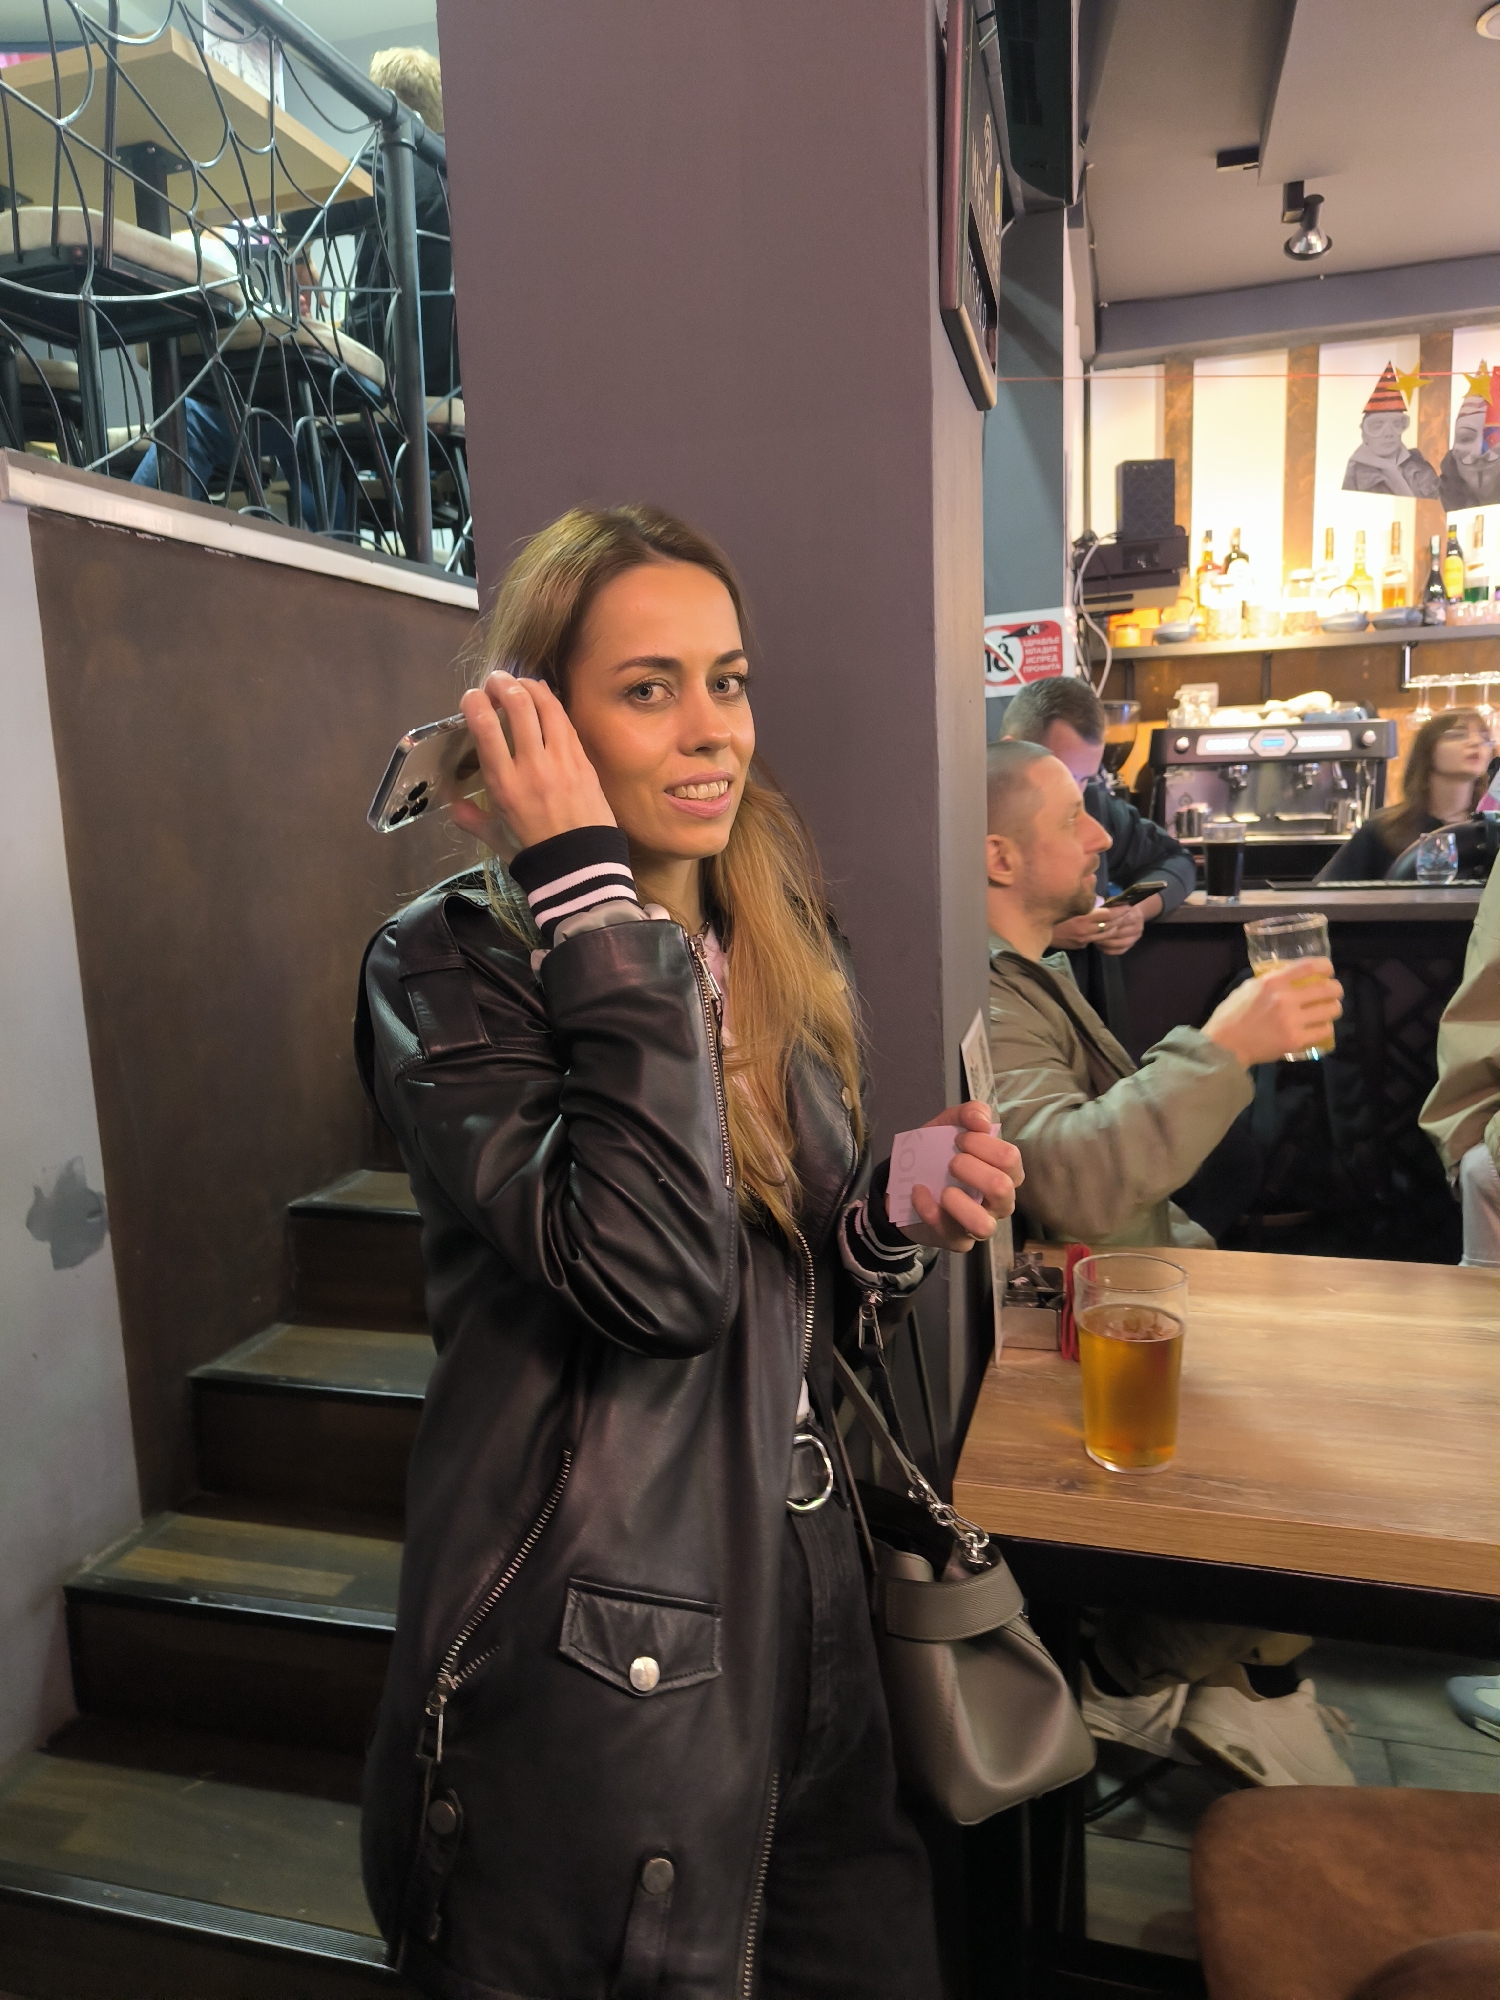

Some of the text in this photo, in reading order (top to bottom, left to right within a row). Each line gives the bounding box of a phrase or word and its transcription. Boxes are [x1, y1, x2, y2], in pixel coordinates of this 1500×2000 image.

[985, 198, 1000, 287] CODE
[1023, 637, 1060, 646] ЗДРАВЉЕ
[1024, 645, 1059, 655] МЛАДИХ
[1025, 655, 1058, 664] ИСПРЕД
[1023, 663, 1060, 673] ПРОФИТА
